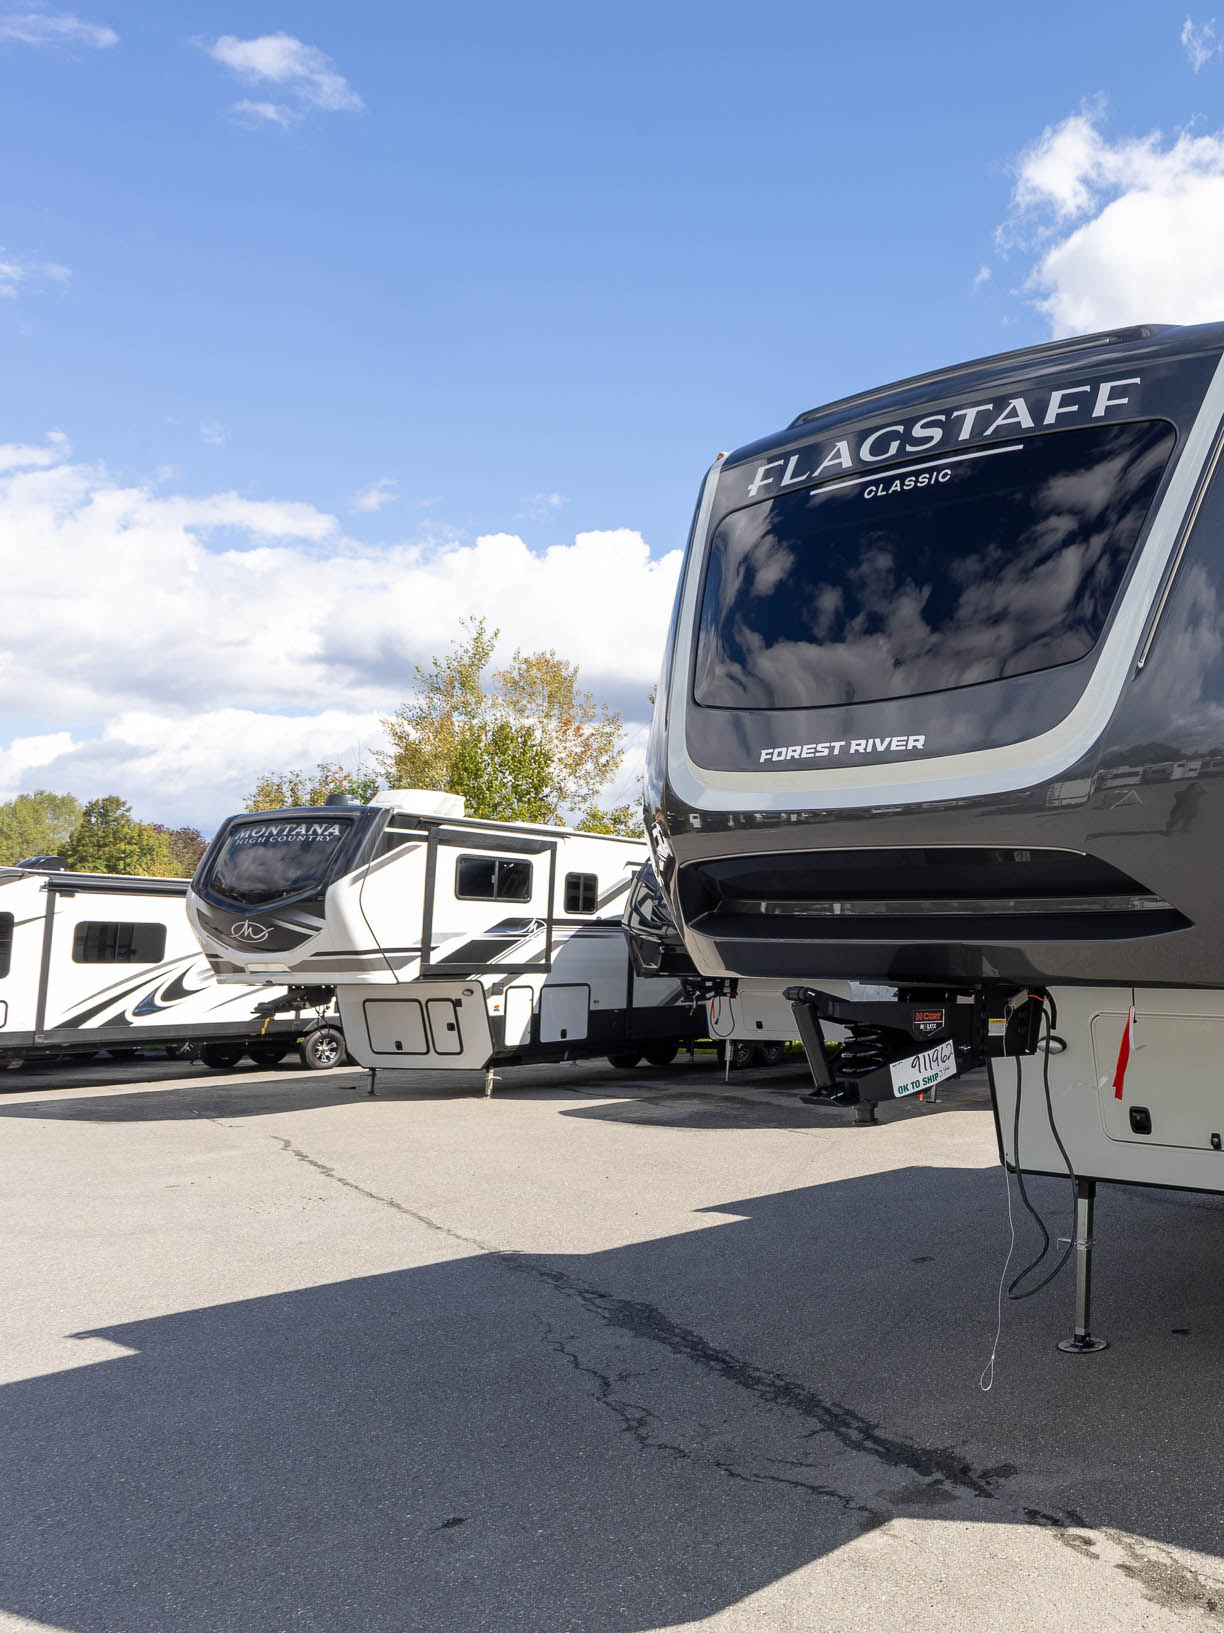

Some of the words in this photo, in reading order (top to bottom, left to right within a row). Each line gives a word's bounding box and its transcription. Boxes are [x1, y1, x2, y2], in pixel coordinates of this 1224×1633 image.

[747, 377, 1141, 498] FLAGSTAFF
[863, 468, 952, 499] CLASSIC
[759, 741, 846, 763] FOREST
[849, 735, 926, 754] RIVER
[234, 823, 340, 840] MONTANA
[235, 836, 266, 845] HIGH
[270, 834, 334, 843] COUNTRY
[897, 1083, 910, 1095] OK
[910, 1079, 921, 1090] TO
[922, 1071, 940, 1086] SHIP
